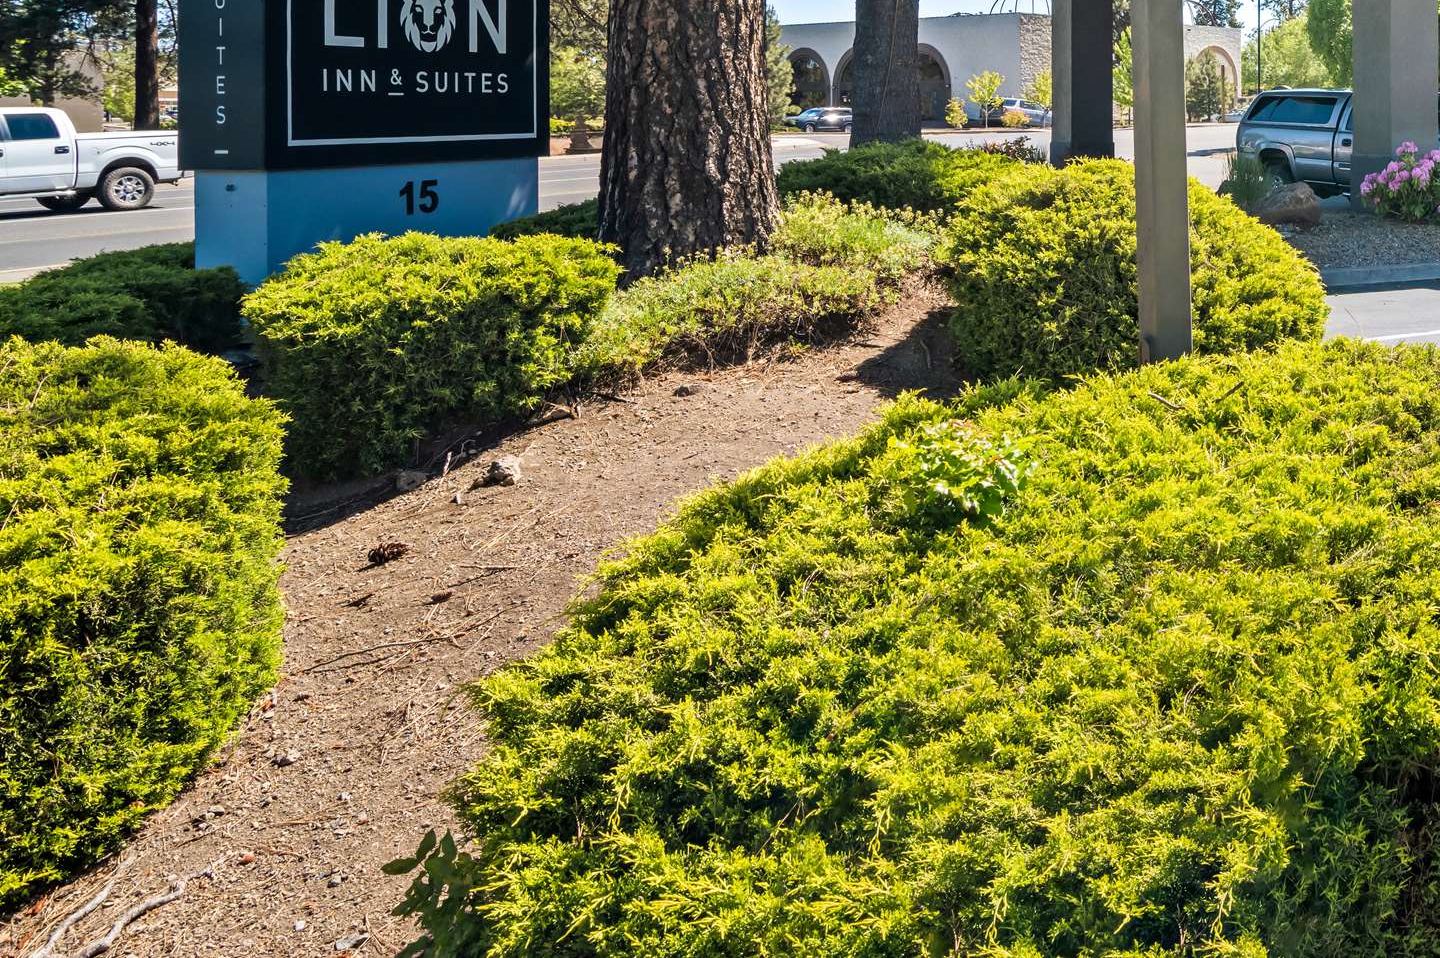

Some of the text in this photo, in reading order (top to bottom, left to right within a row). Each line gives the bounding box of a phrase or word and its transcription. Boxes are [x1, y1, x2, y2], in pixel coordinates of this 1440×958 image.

[322, 68, 510, 96] INN & SUITES
[400, 179, 439, 215] 15
